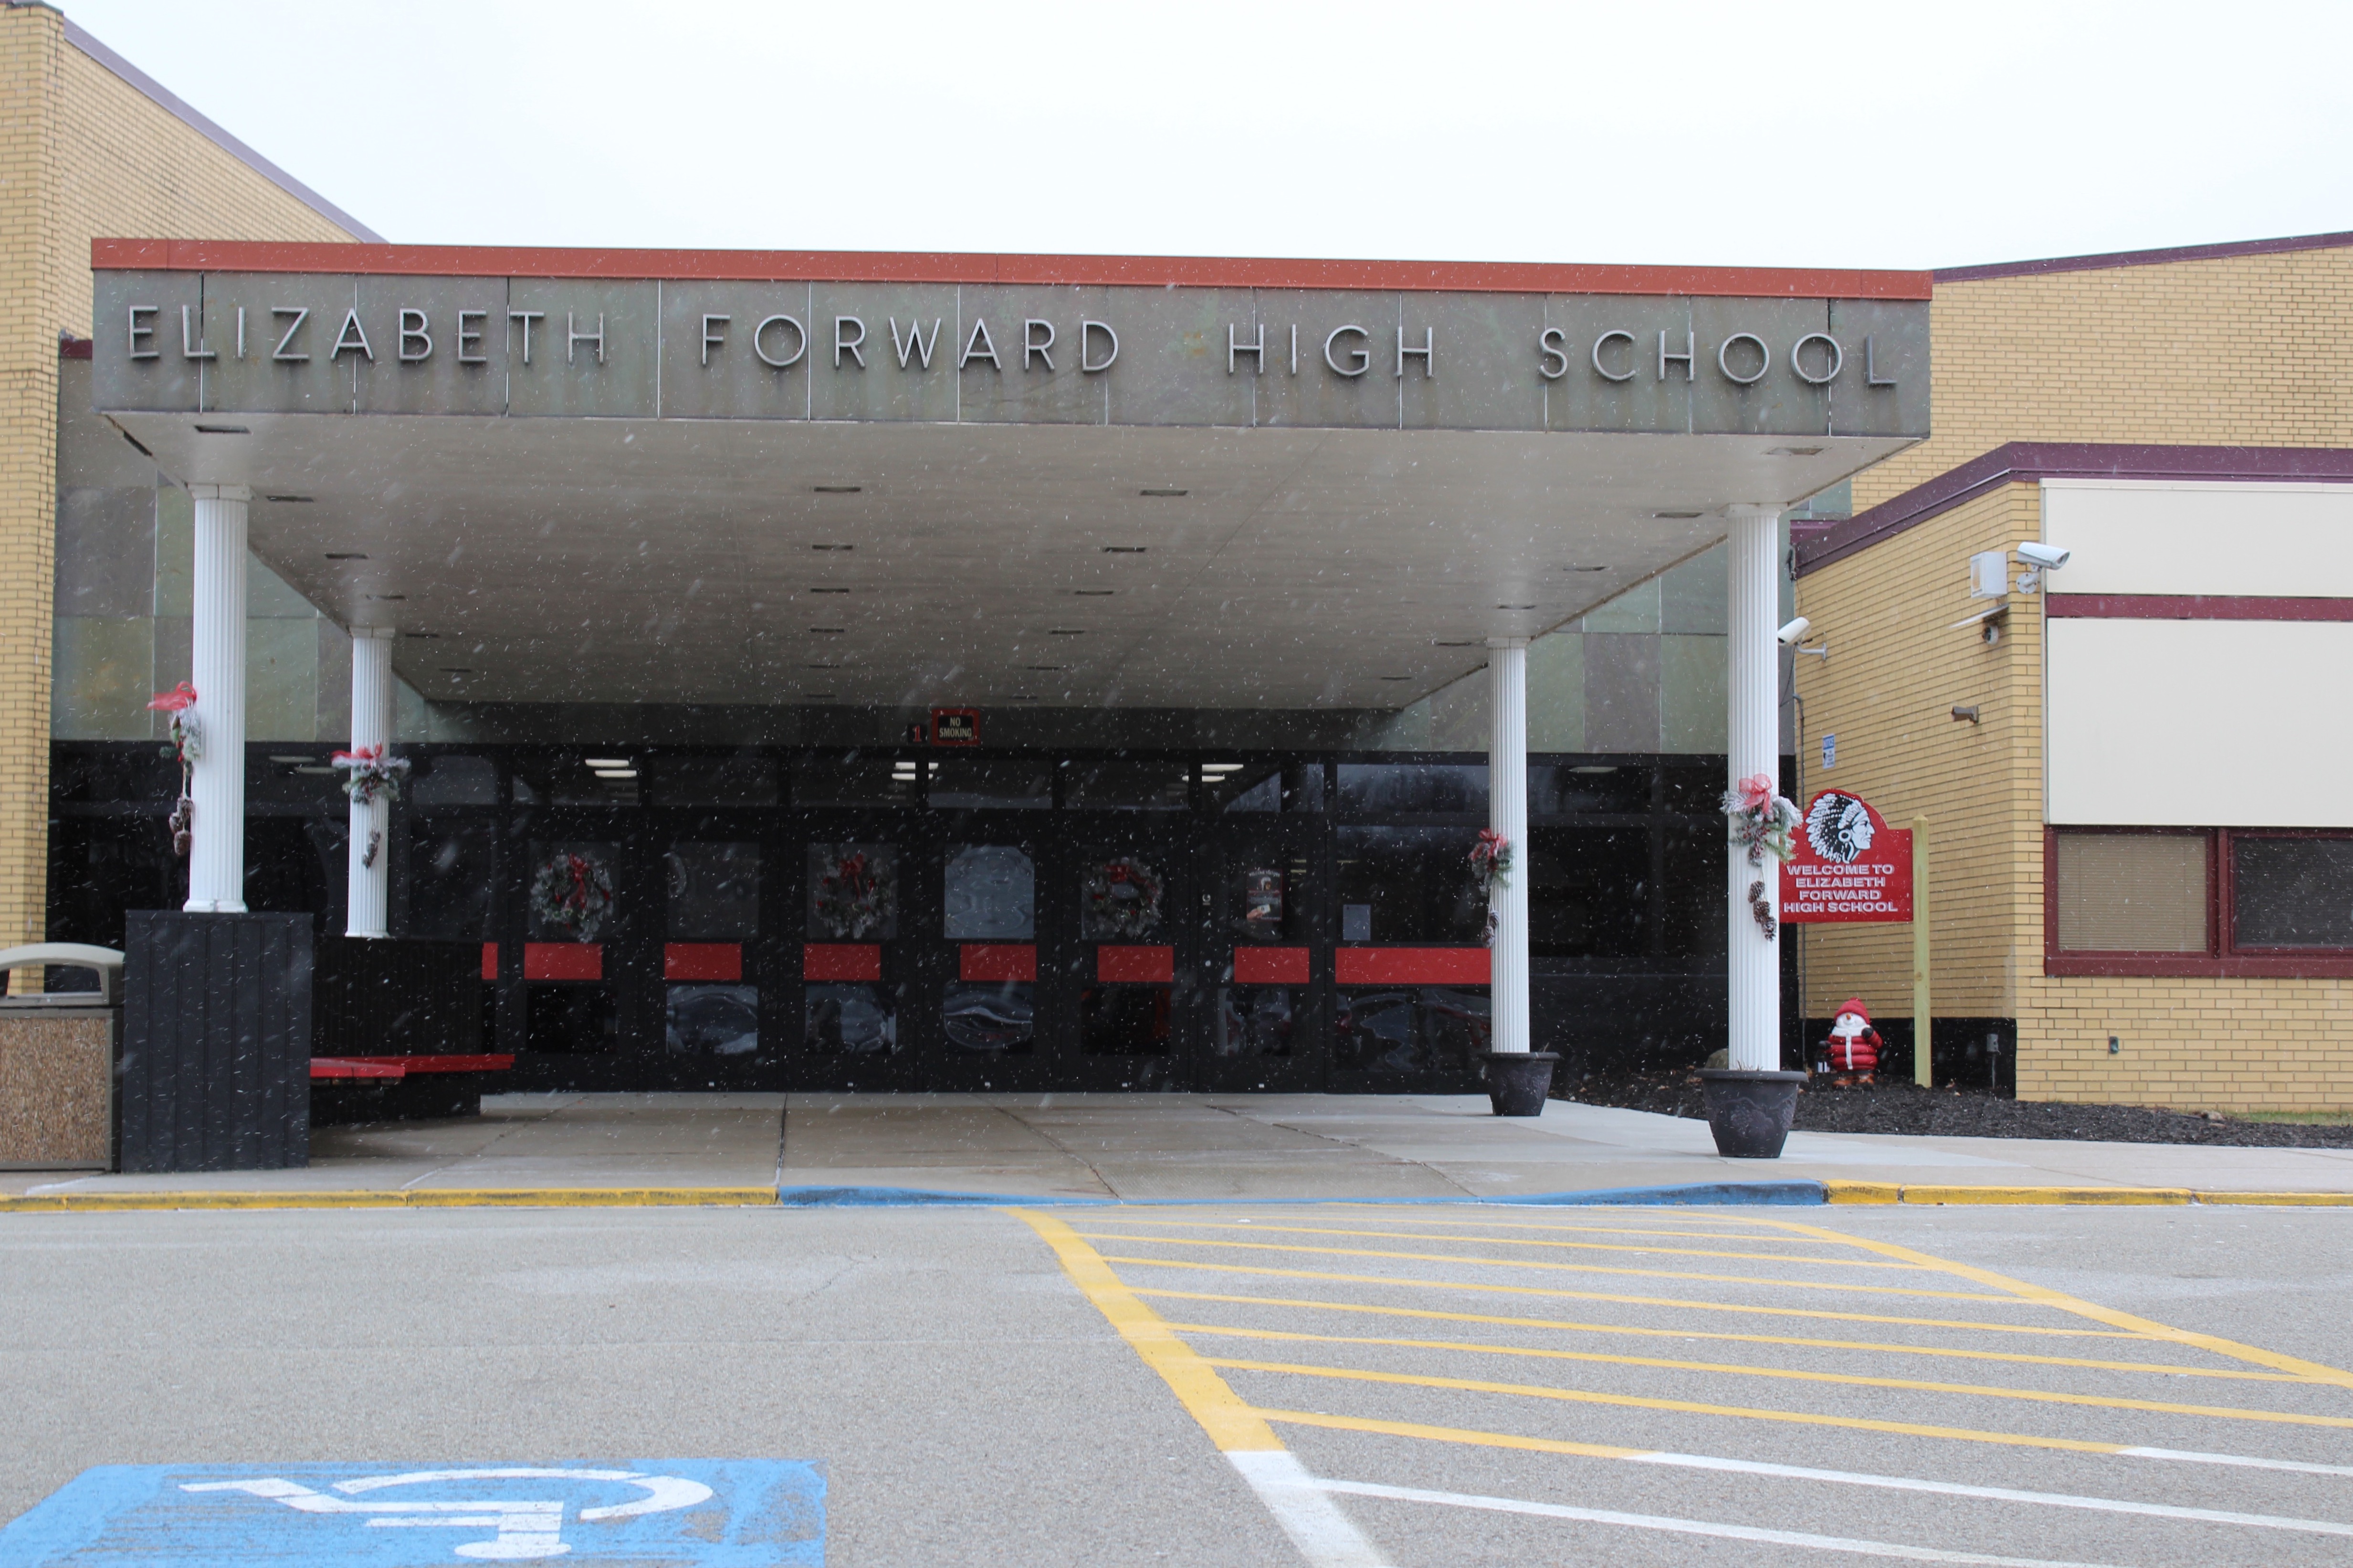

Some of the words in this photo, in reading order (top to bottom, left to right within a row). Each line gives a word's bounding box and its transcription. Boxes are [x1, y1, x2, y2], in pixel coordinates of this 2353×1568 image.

[128, 303, 605, 366] ELIZABETH
[701, 313, 1120, 373] FORWARD
[1228, 323, 1434, 378] HIGH
[1538, 327, 1898, 386] SCHOOL
[950, 717, 961, 727] NO
[912, 725, 922, 742] 1
[939, 727, 972, 738] SMOKING
[1786, 865, 1870, 875] WELCOME
[1872, 864, 1895, 875] TO
[1796, 877, 1885, 888] ELIZABETH
[1799, 889, 1881, 900] FORWARD
[1784, 902, 1824, 912] HIGH
[1828, 901, 1898, 912] SCHOOL
